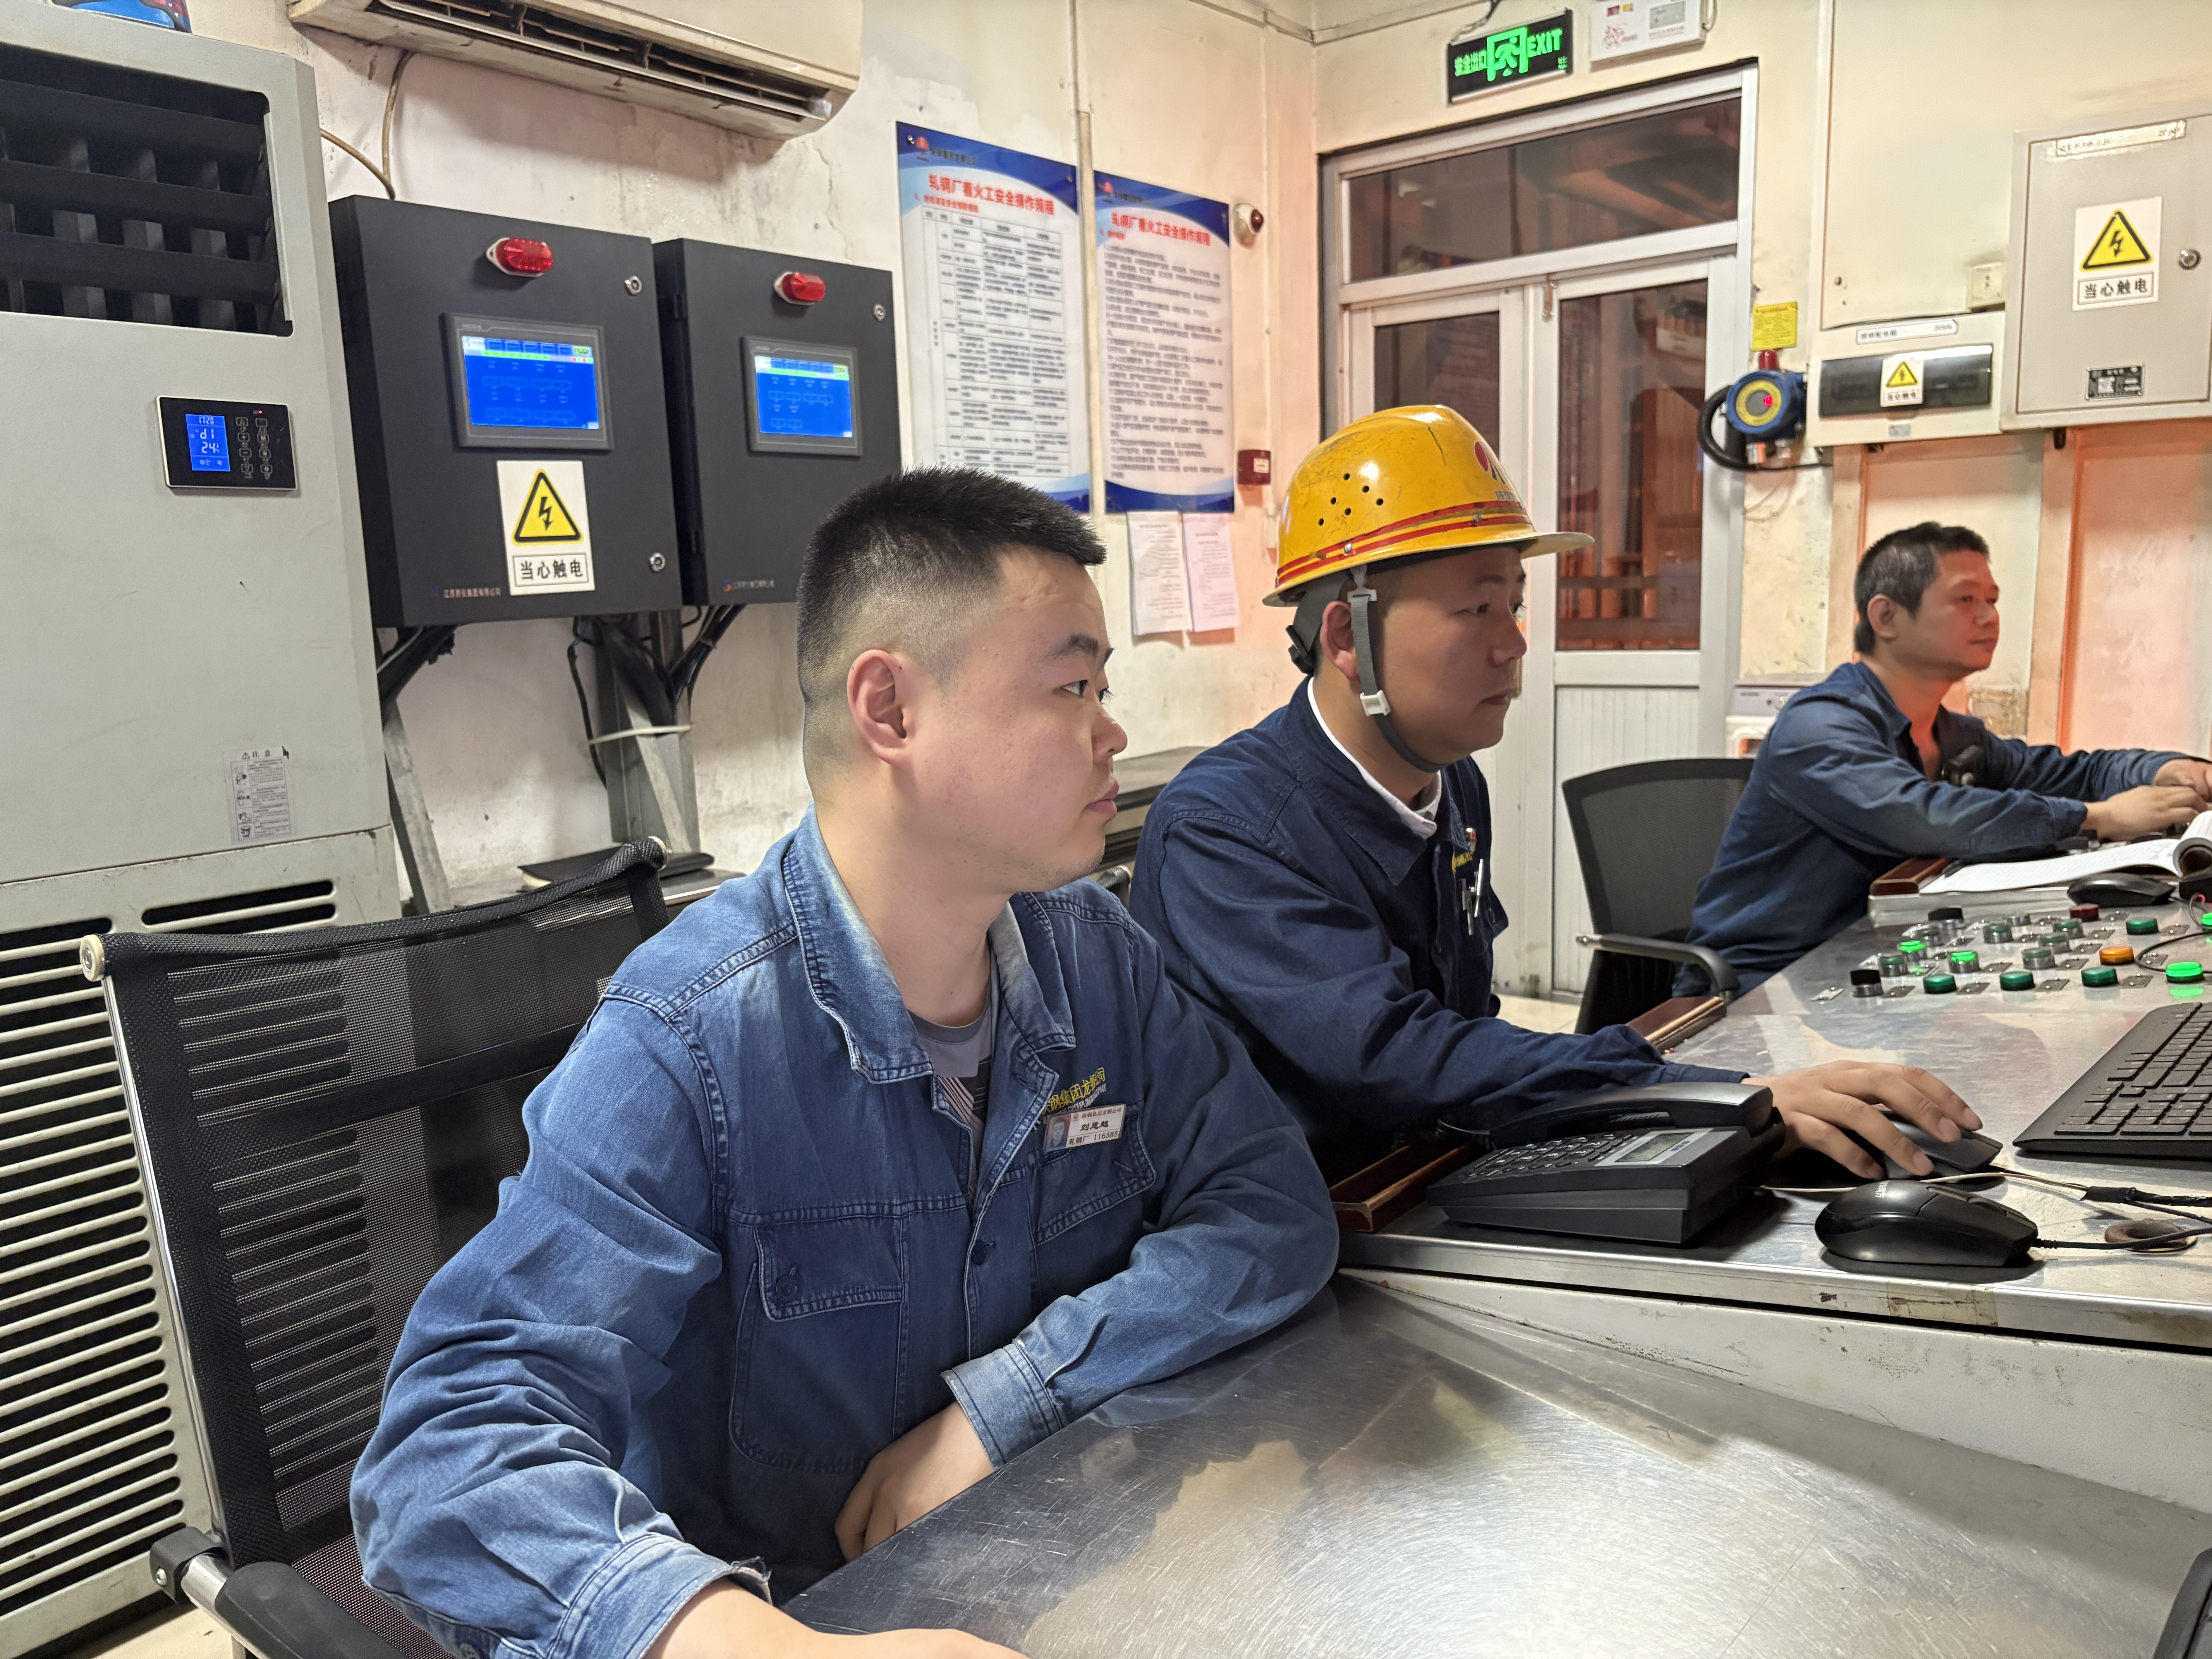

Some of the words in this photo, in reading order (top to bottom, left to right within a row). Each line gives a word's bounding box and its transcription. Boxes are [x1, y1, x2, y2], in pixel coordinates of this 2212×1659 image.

[1527, 27, 1563, 58] EXIT
[929, 173, 1055, 215] 轧钢厂看火工安全操作规程
[2084, 277, 2148, 299] 当心触电
[520, 559, 583, 580] 当心触电
[1068, 1136, 1090, 1145] 轧钢厂
[1094, 1131, 1118, 1140] 116585
